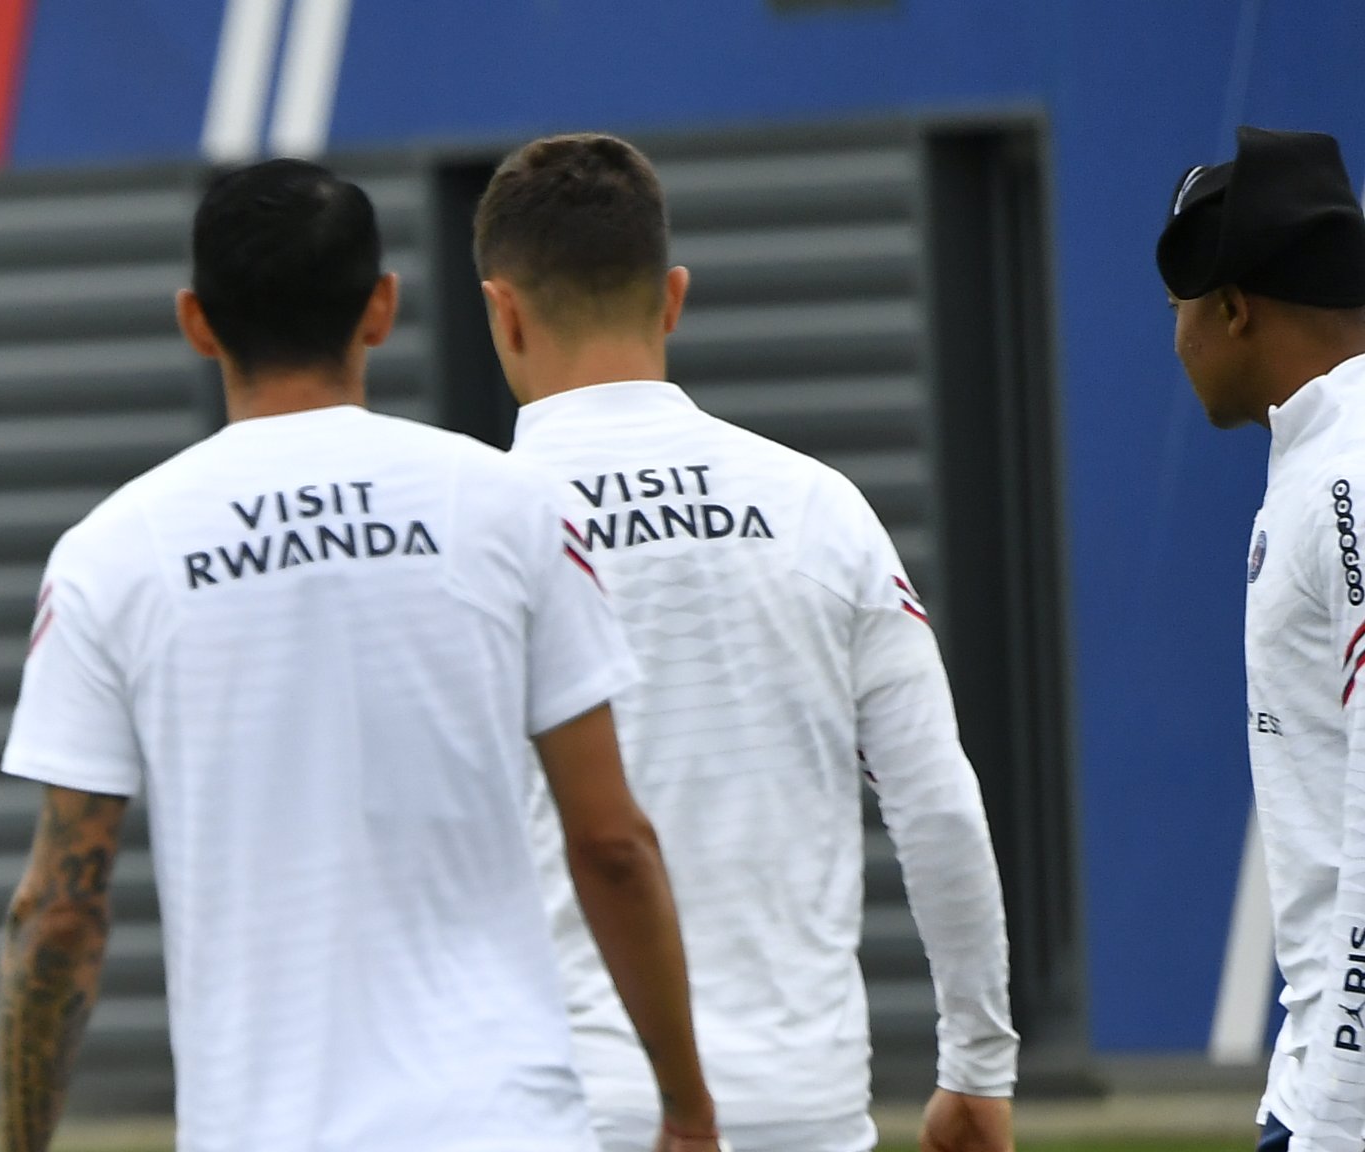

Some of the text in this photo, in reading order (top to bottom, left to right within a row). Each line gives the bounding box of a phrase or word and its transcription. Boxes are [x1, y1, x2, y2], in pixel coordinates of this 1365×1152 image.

[229, 482, 373, 530] VISIT
[569, 465, 710, 508] VISIT
[581, 504, 775, 553] WANDA
[184, 520, 439, 590] RWANDA
